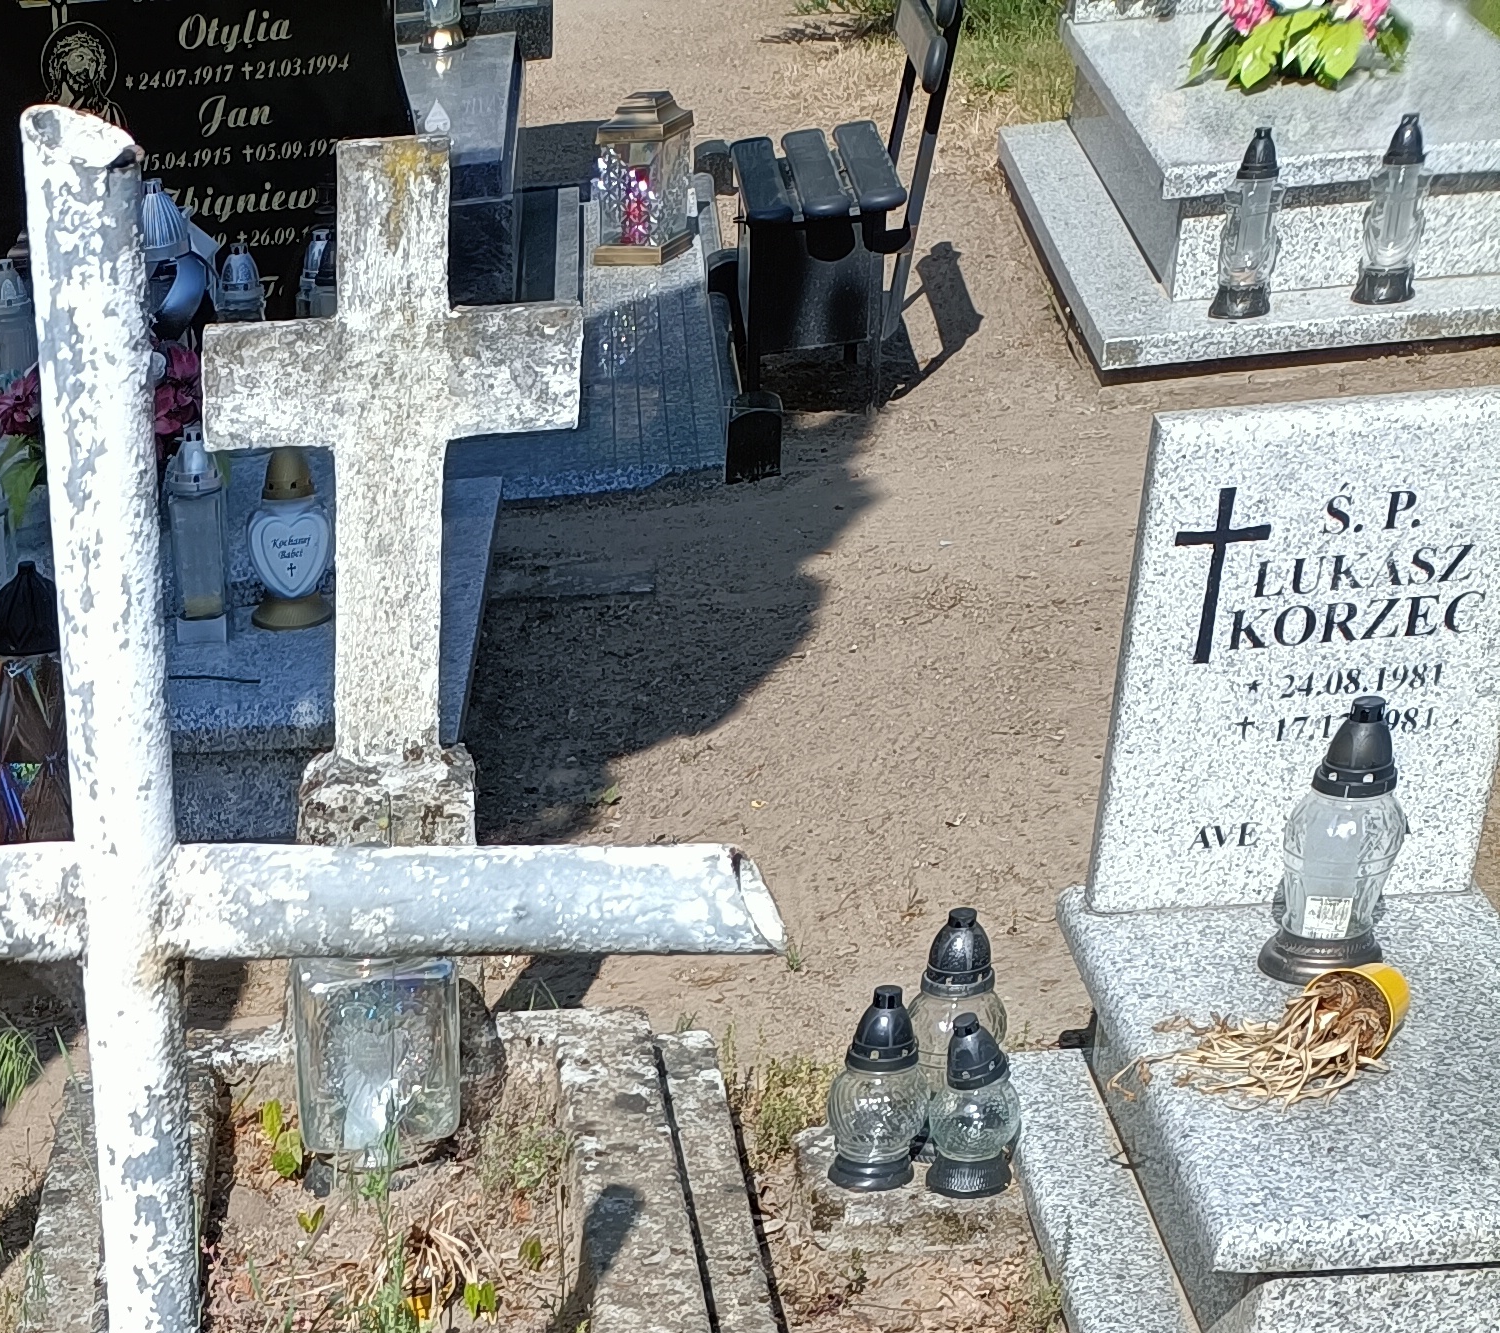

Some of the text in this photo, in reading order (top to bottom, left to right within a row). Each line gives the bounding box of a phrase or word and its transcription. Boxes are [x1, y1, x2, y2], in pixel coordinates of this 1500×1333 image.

[178, 9, 293, 53] Otylia
[138, 52, 350, 91] 24.07.1917 21.03.1994
[199, 95, 273, 138] Jan
[255, 138, 340, 163] 05.09.197
[1322, 482, 1421, 535] Ś. P.
[1227, 590, 1486, 651] KORZEC
[1280, 662, 1444, 700] 24.08.1981
[1188, 821, 1263, 850] AVE
